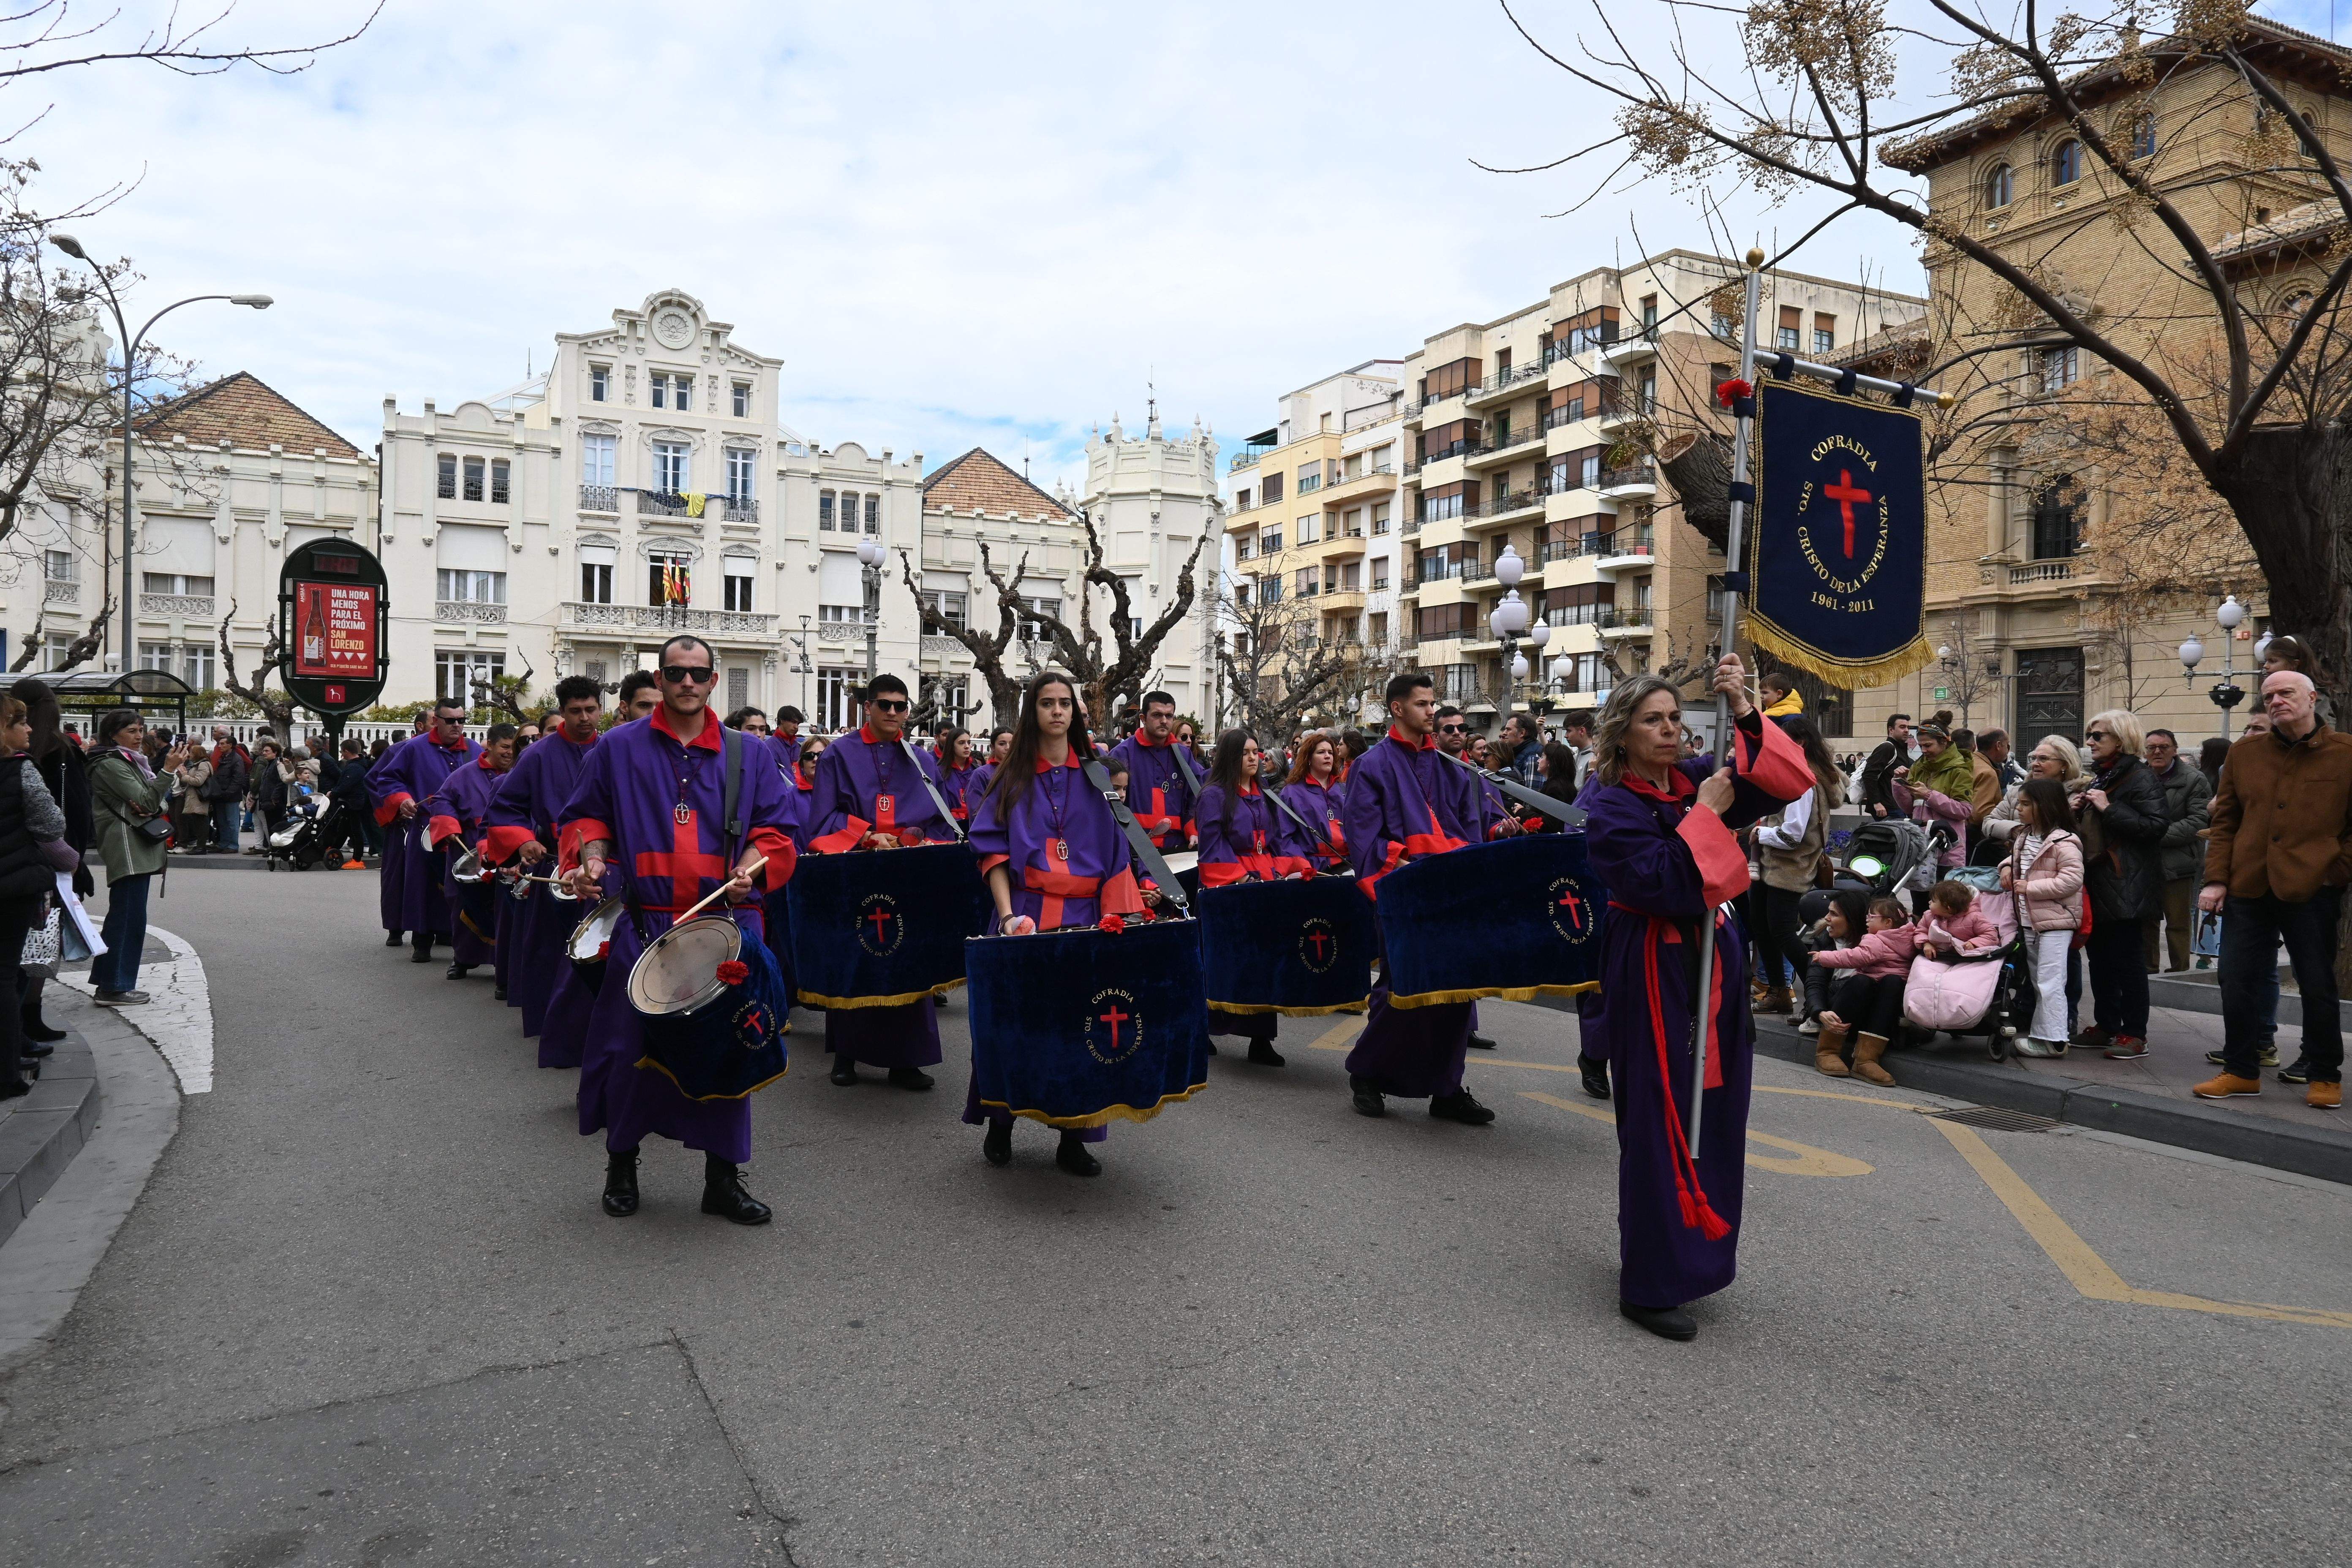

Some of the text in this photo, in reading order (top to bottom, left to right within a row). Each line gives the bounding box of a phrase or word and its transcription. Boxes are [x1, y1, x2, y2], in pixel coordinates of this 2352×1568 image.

[1811, 435, 1877, 472] COFRADIA
[1797, 481, 1889, 594] STO. CRISTO DE LA ESPERANZA
[332, 589, 369, 600] UNA HORA
[1810, 591, 1838, 610] 1961
[1848, 598, 1875, 612] 2011
[331, 599, 358, 610] MENOS
[331, 609, 362, 620] PARA EL
[331, 619, 365, 630] PRÓXIMO
[331, 630, 346, 639] SAN
[331, 639, 364, 650] LORENZO
[1549, 877, 1579, 891] COFRADIA
[862, 894, 896, 906] COFRADIA
[1303, 917, 1331, 928] COFRADIA
[1553, 920, 1571, 940] CRISTO
[1584, 898, 1593, 936] ESPERANZA
[858, 934, 873, 953] CRISTO
[892, 914, 904, 950] ESPERANZA
[1300, 953, 1312, 969] CRISTO
[1092, 988, 1134, 1004] COFRADIA
[1086, 1040, 1104, 1062] CRISTO
[1126, 1012, 1143, 1055] ESPERANZA
